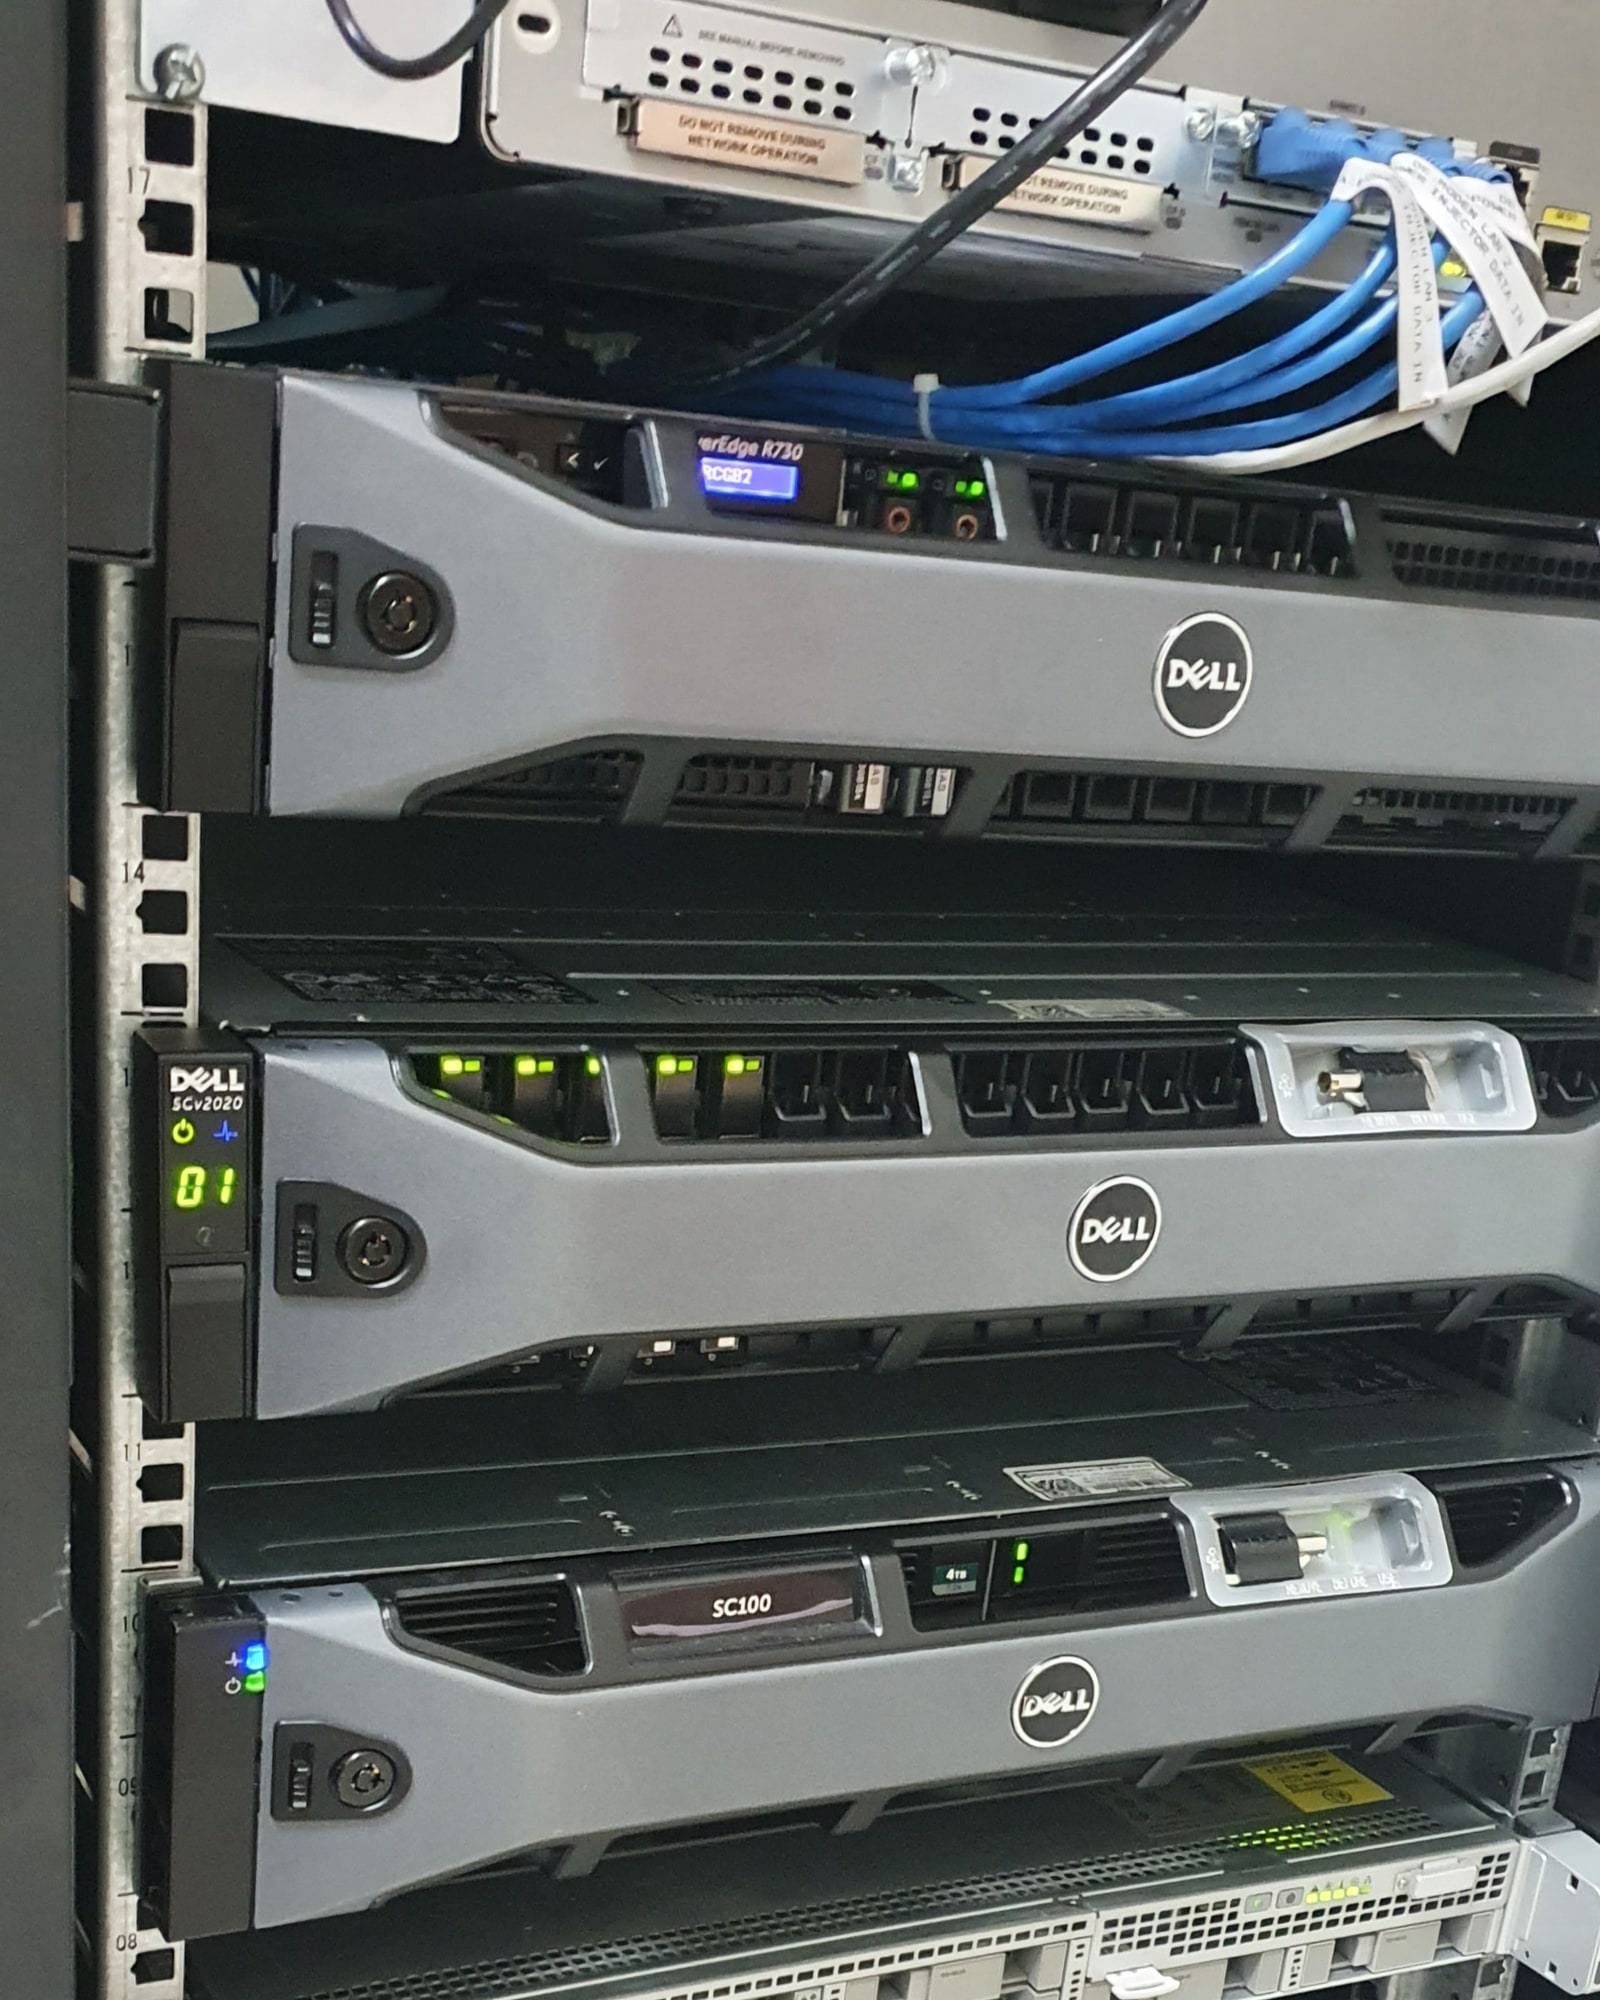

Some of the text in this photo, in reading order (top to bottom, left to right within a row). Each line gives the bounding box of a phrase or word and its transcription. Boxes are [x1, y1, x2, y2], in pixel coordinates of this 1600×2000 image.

[678, 114, 827, 150] DO NOT REMOVE DURING
[687, 134, 820, 166] NETWORK OPERATION
[127, 166, 150, 195] 17
[1040, 177, 1086, 193] REMOVE
[1086, 183, 1129, 200] DURING
[1060, 195, 1122, 214] OPERATION
[1431, 187, 1489, 256] INJECTOR
[1413, 305, 1424, 353] DATA
[698, 434, 805, 461] erEdge R730
[1167, 658, 1241, 692] DELL
[121, 861, 145, 884] 14
[169, 1066, 245, 1093] DELL
[172, 1095, 243, 1112] SCv2020
[176, 1166, 234, 1208] 01
[1081, 1214, 1151, 1245] DELL
[123, 1443, 142, 1462] 11
[712, 1593, 772, 1618] SC100
[1021, 1688, 1091, 1718] DELL
[115, 1934, 137, 1951] 08
